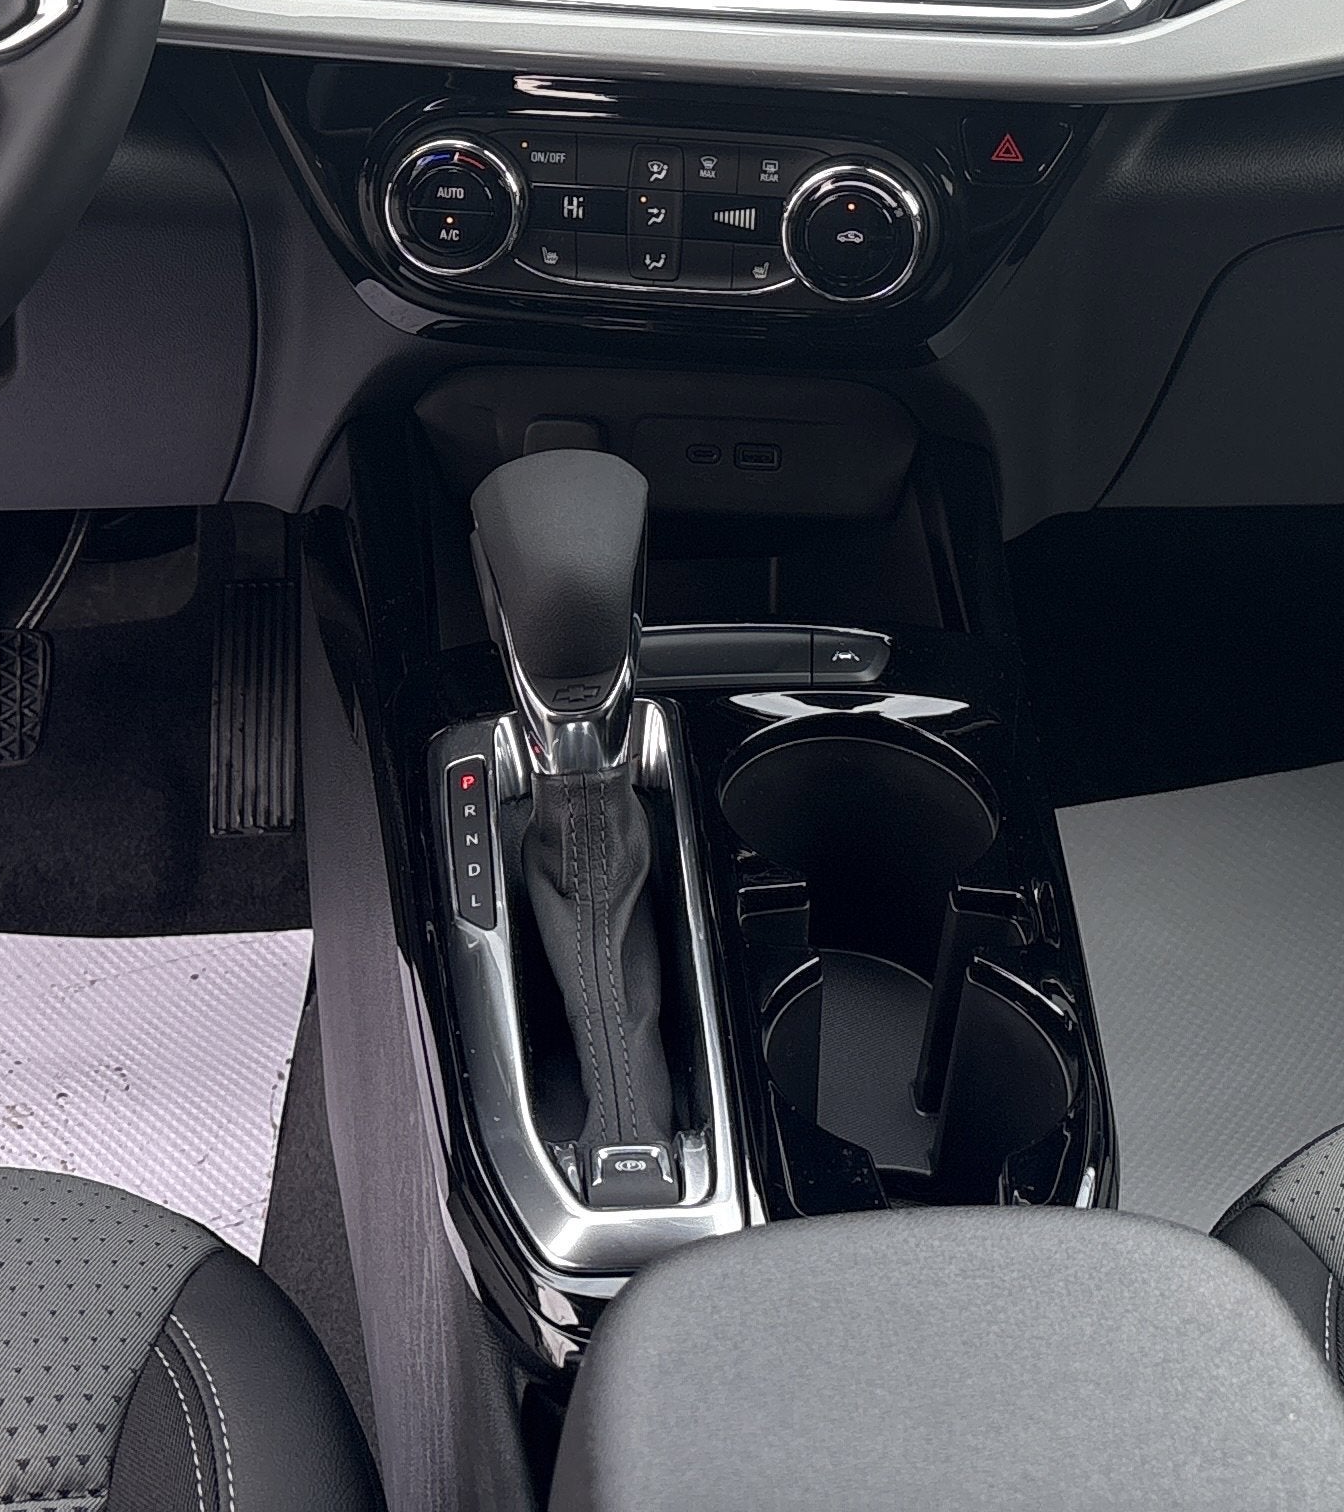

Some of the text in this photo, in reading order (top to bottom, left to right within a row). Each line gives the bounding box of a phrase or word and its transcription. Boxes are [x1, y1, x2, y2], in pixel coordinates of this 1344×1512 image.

[530, 151, 566, 163] ON/OFF
[699, 169, 716, 179] MAX
[760, 172, 779, 182] REAR
[437, 187, 465, 199] AUTO
[563, 196, 584, 219] Hi
[439, 229, 460, 241] A/C
[461, 776, 474, 789] P
[464, 805, 477, 817] R
[466, 833, 479, 846] N
[468, 864, 481, 877] D
[471, 895, 482, 907] L
